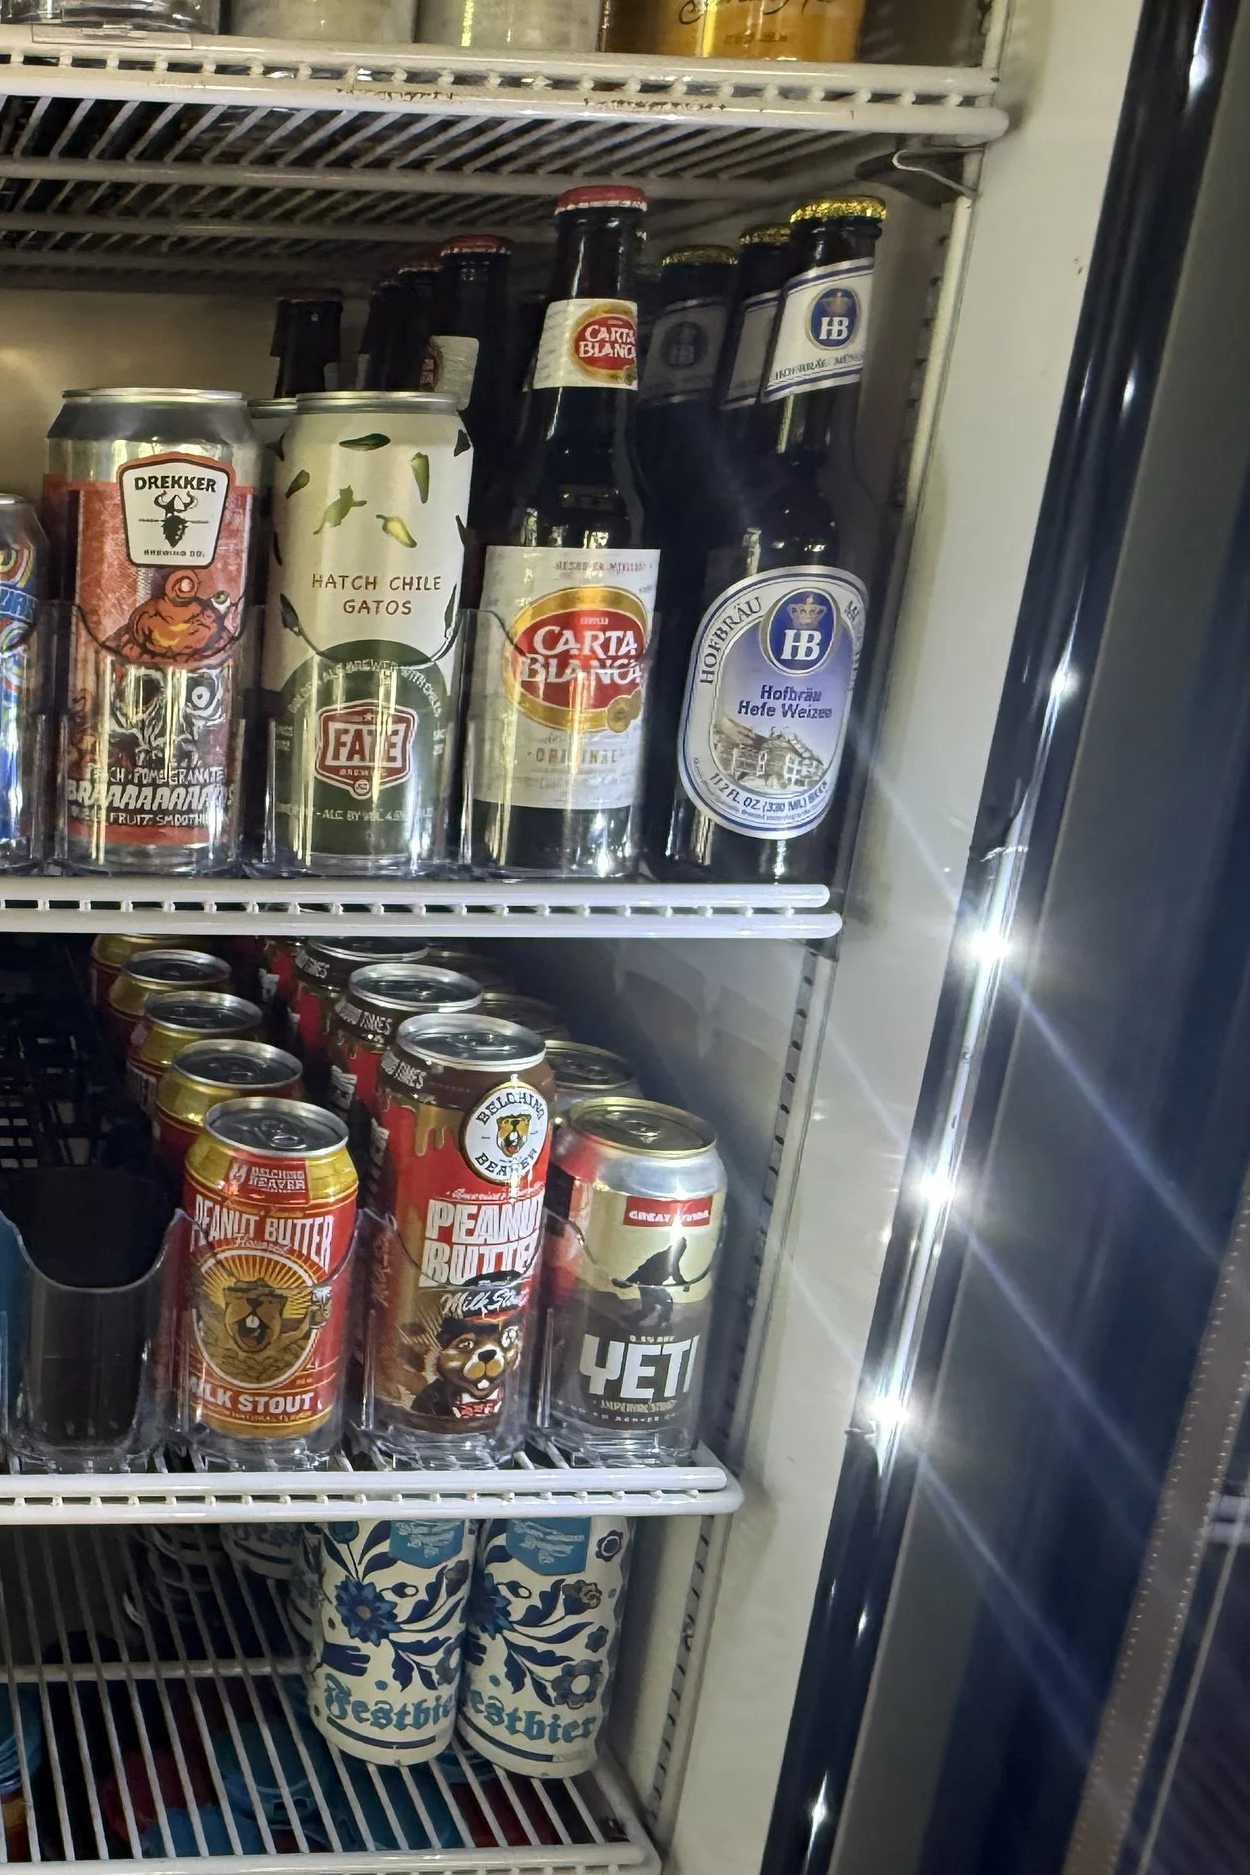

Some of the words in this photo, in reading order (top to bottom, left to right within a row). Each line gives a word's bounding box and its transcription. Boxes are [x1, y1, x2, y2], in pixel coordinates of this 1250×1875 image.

[584, 324, 636, 345] CARTA
[818, 316, 849, 341] HB
[578, 341, 637, 359] BLANC
[134, 475, 217, 493] DREKKER
[311, 573, 378, 591] HATCH
[388, 574, 442, 592] CHILE
[342, 599, 413, 616] GATOS
[533, 625, 638, 659] CARTA
[699, 595, 764, 686] HOFBRÄU
[780, 628, 823, 661] HB
[520, 653, 642, 686] BLANCA
[759, 684, 823, 702] Hofbräu
[737, 699, 776, 718] Hefe
[781, 702, 833, 719] Weizen
[331, 727, 401, 763] FATE
[535, 747, 618, 765] ORIINAL
[155, 813, 212, 827] SMOOTHI
[475, 1090, 546, 1126] BELCHING
[425, 1192, 545, 1244] PEANU
[628, 1210, 672, 1223] GREAT
[194, 1194, 260, 1245] PEANUT
[263, 1214, 334, 1273] BUTTER
[419, 1230, 540, 1288] BUTT
[440, 1291, 491, 1319] Milk
[578, 1333, 701, 1399] YETI
[237, 1391, 315, 1414] STOUT
[323, 1672, 453, 1732] Festbi
[464, 1688, 598, 1744] estbier
